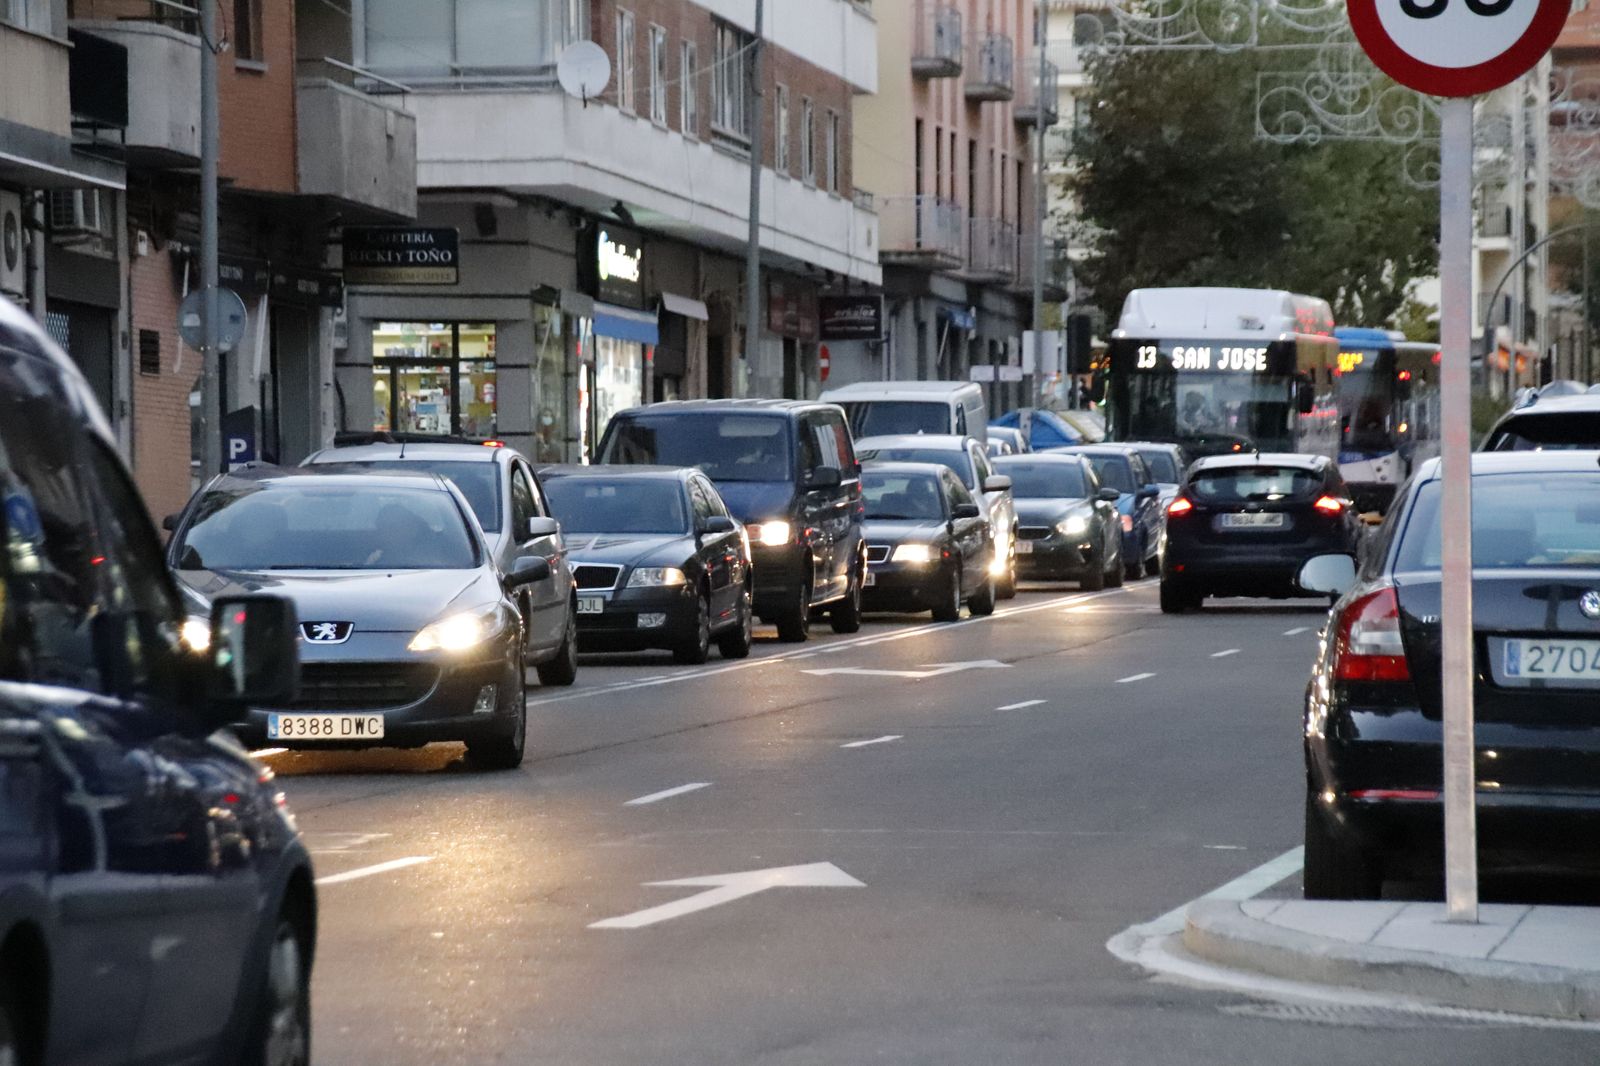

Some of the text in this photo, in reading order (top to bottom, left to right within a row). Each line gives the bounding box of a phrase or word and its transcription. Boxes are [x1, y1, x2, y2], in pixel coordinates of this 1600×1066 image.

[406, 247, 452, 263] TOÑO
[1137, 346, 1268, 371] 13 SAN JOSE
[229, 438, 248, 460] P
[576, 599, 601, 612] DJL
[282, 717, 380, 736] 8388 DWC
